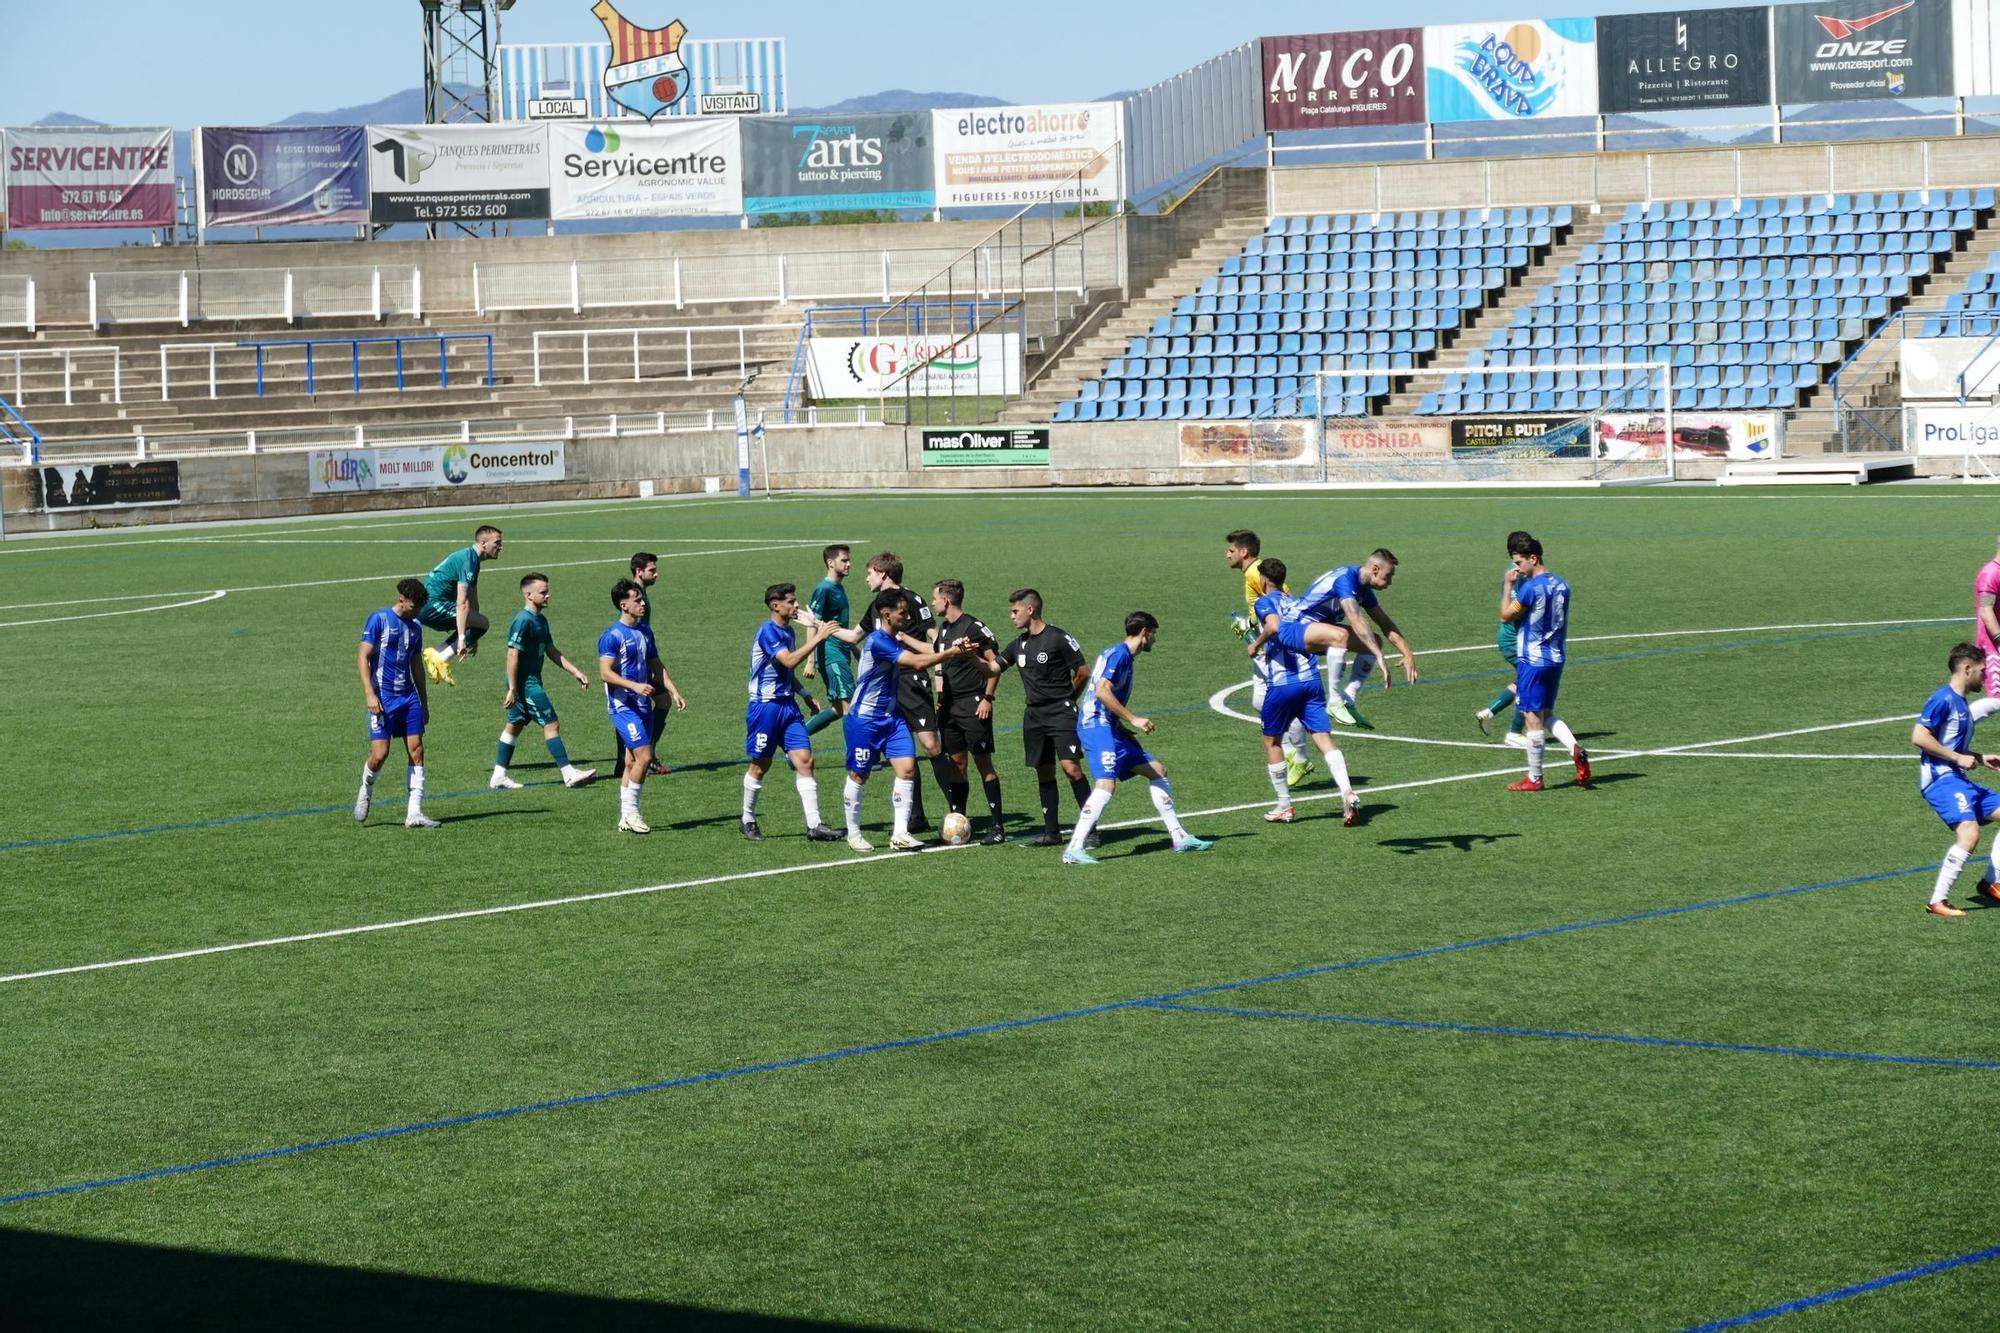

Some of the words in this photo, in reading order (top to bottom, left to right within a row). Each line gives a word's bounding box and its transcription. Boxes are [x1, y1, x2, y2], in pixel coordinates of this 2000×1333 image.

[1815, 39, 1908, 58] ONZE
[1479, 32, 1536, 84] AQUA
[1629, 53, 1738, 74] ALLEGRO
[1810, 57, 1913, 72] www.onzesport.com
[1270, 43, 1414, 92] NICO
[1469, 53, 1533, 116] BRAVA
[1639, 81, 1673, 90] Pizzeria
[1684, 79, 1729, 88] Ristorante
[1830, 80, 1865, 90] Proveedor
[1866, 79, 1886, 88] oficial
[1271, 86, 1415, 103] XURRERIA
[538, 102, 577, 115] LOCAL
[704, 97, 757, 110] VISITANT
[1320, 105, 1351, 114] Catalunya
[1351, 103, 1387, 112] FIGUERES
[820, 126, 856, 136] seven
[307, 143, 341, 154] tranquil
[439, 145, 478, 159] TANQUES
[480, 143, 541, 156] PERIMETRALS
[10, 145, 169, 171] SERVICENTRE
[564, 152, 726, 178] Servicentre
[638, 177, 695, 187] AGRONOMIC
[697, 177, 727, 186] VALUE
[798, 169, 828, 181] tattoo
[830, 169, 839, 180] &
[840, 169, 882, 182] piercing
[62, 190, 80, 203] 972
[389, 192, 531, 204] www.tanquesperimetrals.com
[651, 192, 683, 201] ESPAIS
[684, 191, 716, 200] VERDS
[414, 206, 434, 218] Tel.
[436, 206, 458, 217] 972
[460, 205, 482, 216] 562
[484, 204, 507, 216] 600
[1465, 424, 1502, 437] PITCH
[1505, 426, 1513, 436] &
[1514, 423, 1548, 436] PUTT
[1925, 422, 1999, 445] ProLiga
[929, 432, 1005, 448] masOliver
[1340, 432, 1423, 449] TOSHIBA
[379, 462, 401, 475] MOLT
[402, 460, 434, 473] MILLOR!
[627, 722, 637, 735] 9
[755, 732, 768, 747] 12
[855, 748, 870, 761] 20
[1101, 751, 1117, 765] 22
[1954, 792, 1968, 806] 3
